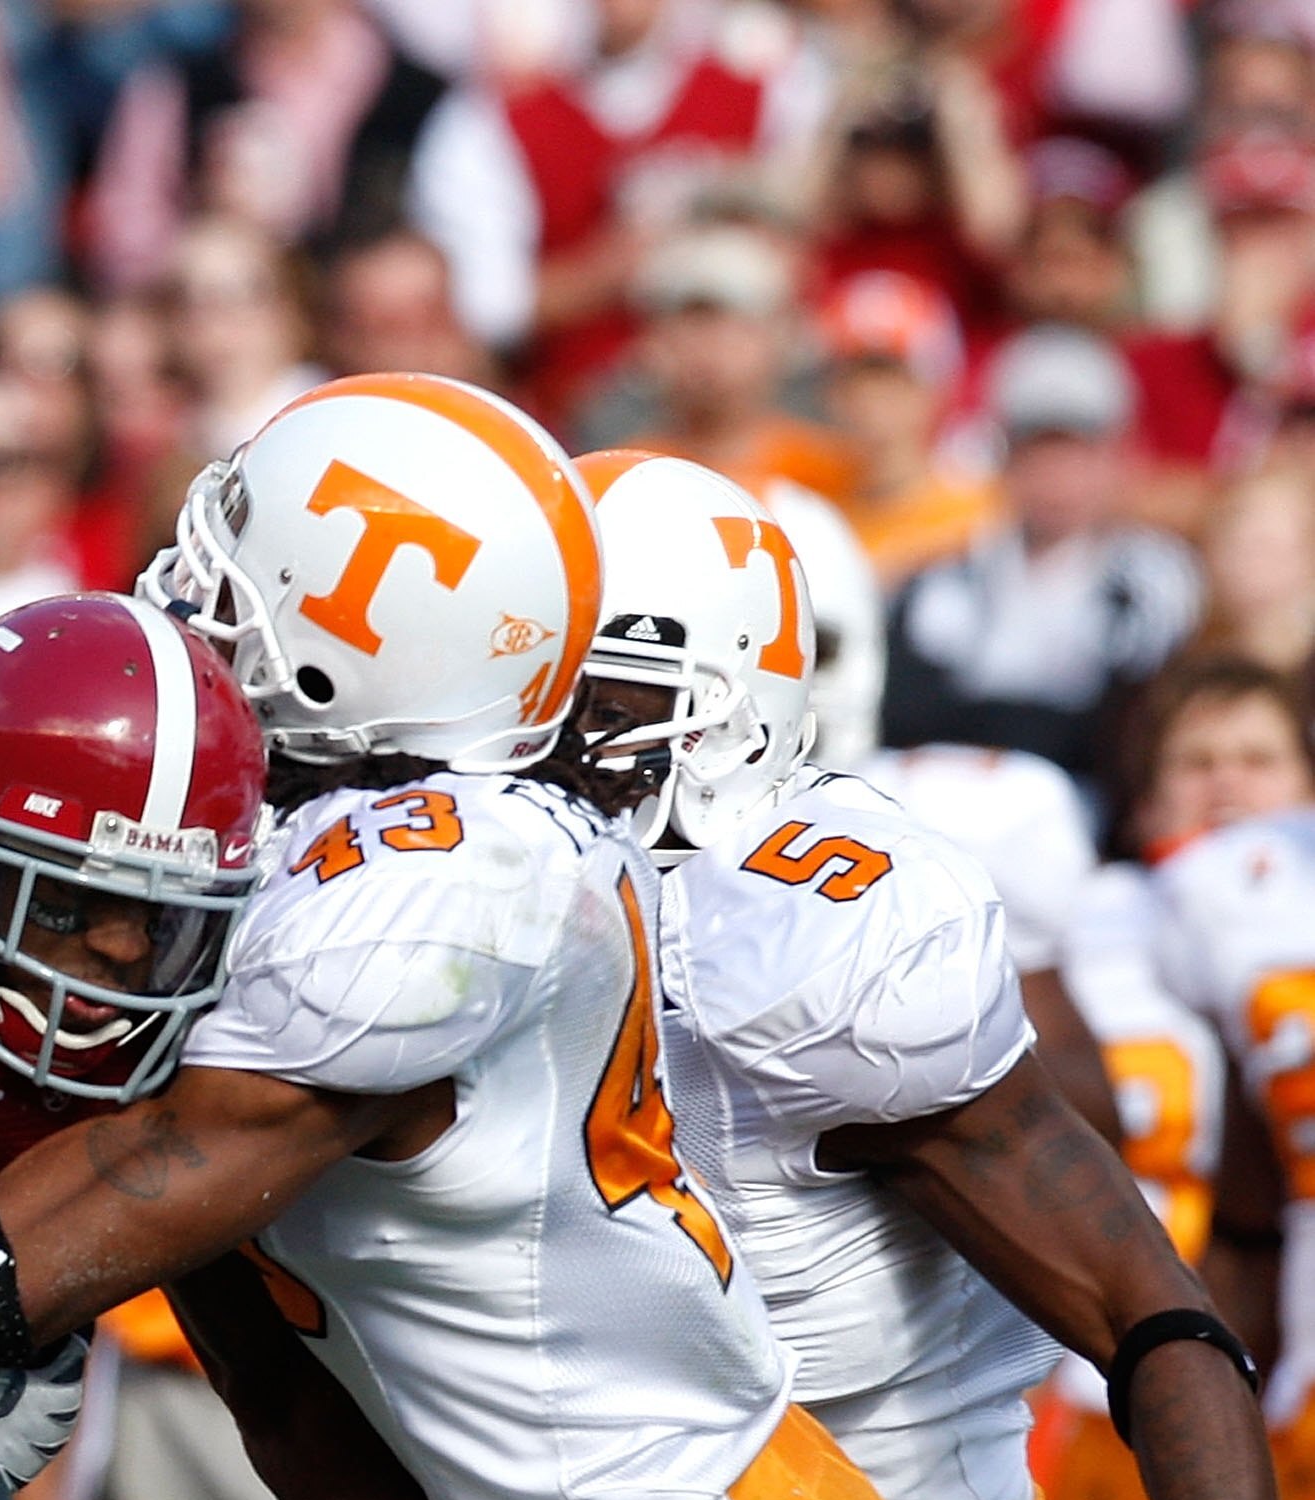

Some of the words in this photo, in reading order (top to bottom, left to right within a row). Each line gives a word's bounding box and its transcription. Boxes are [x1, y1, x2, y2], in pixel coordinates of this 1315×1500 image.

[298, 458, 482, 657] T
[711, 516, 804, 680] T
[23, 792, 63, 818] NIKE
[126, 828, 185, 854] BAMA
[289, 789, 465, 885] 43
[740, 820, 894, 903] 5
